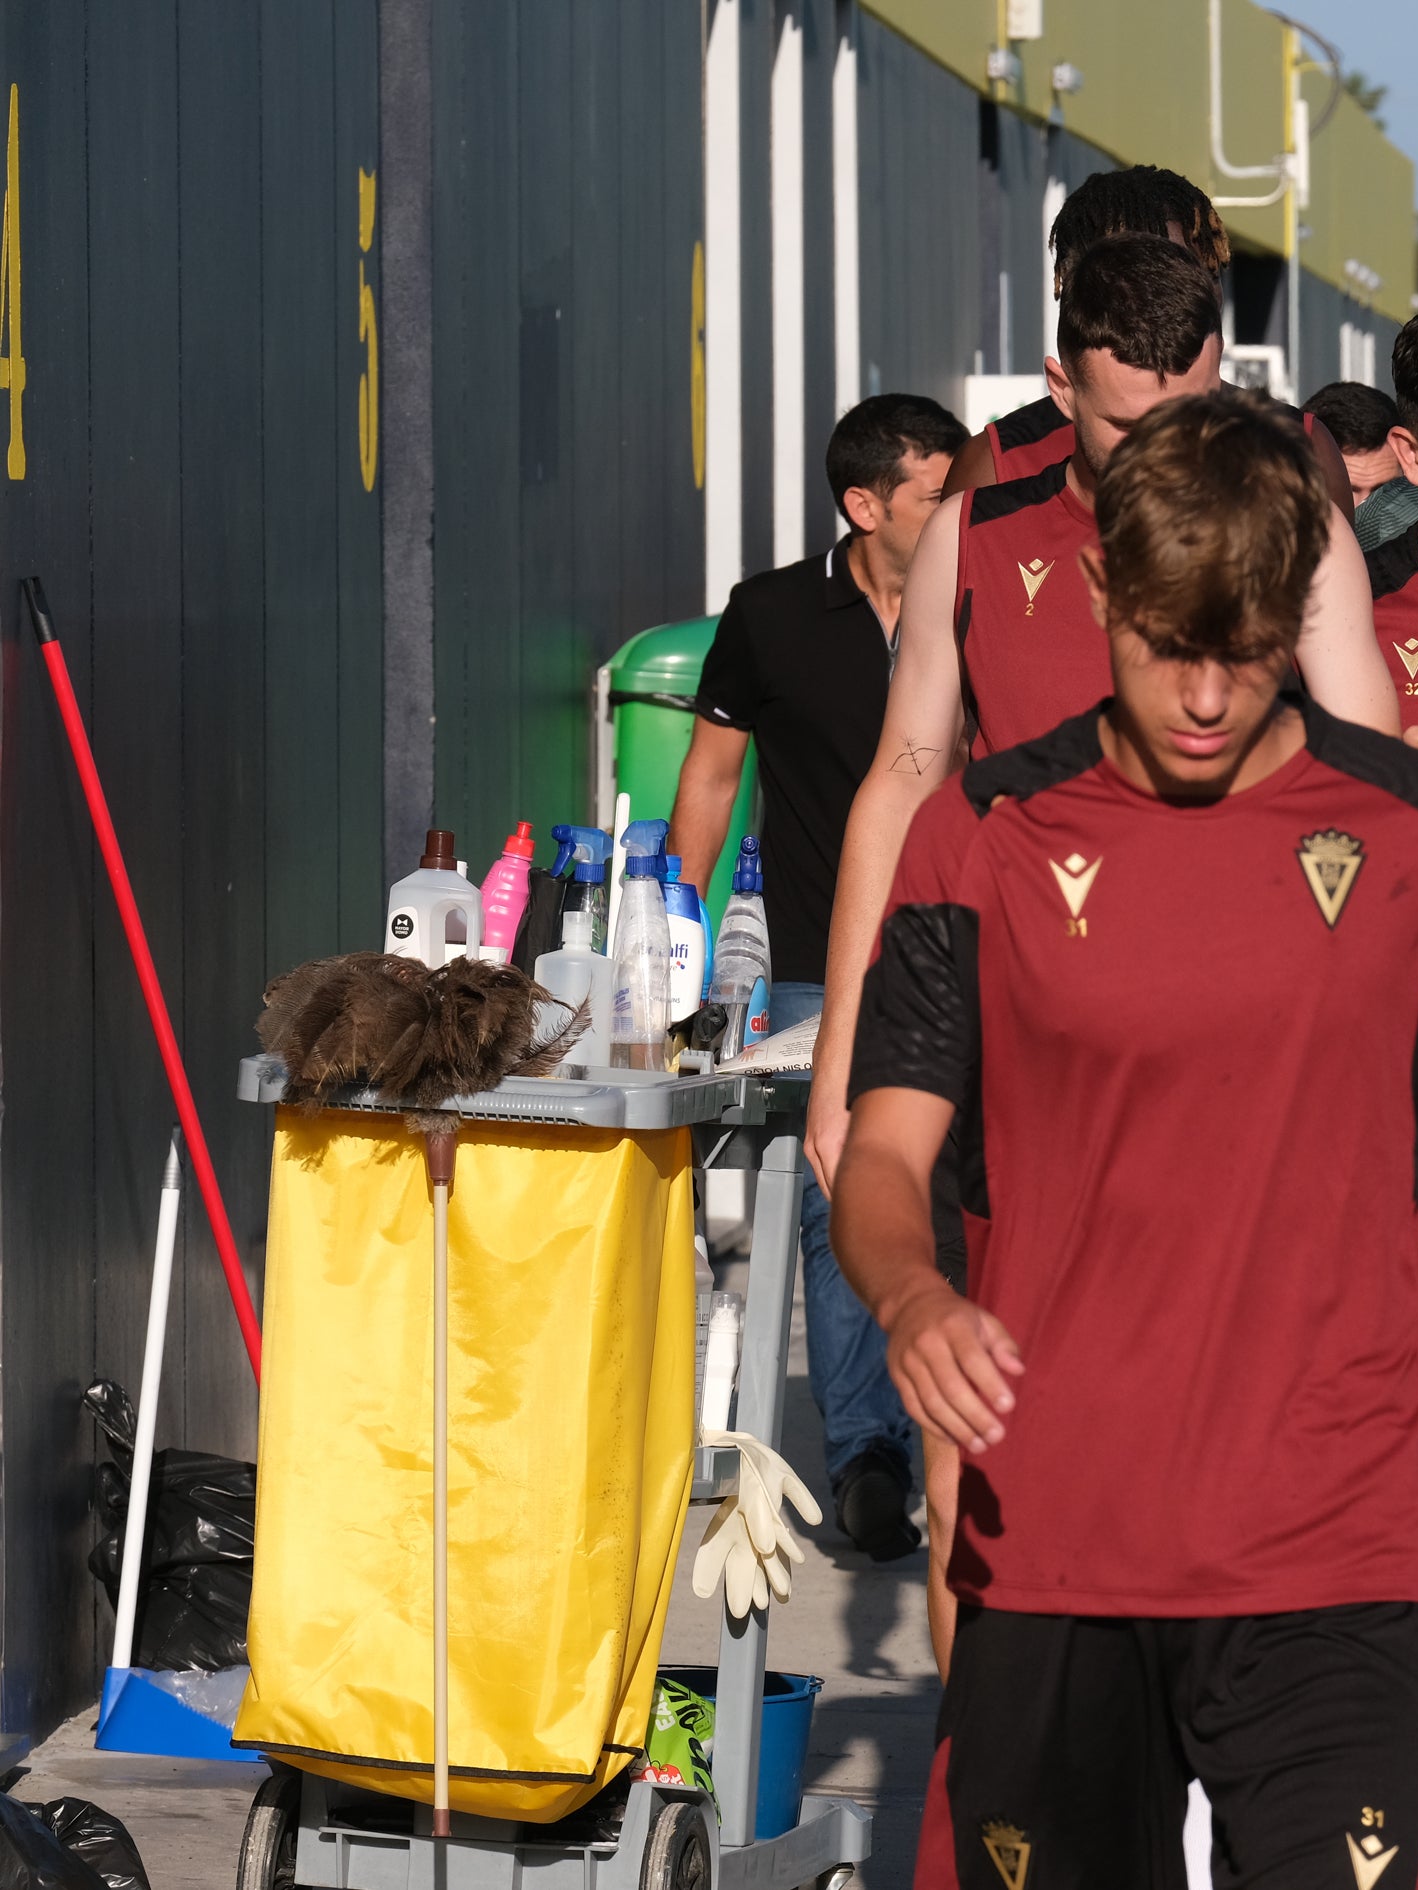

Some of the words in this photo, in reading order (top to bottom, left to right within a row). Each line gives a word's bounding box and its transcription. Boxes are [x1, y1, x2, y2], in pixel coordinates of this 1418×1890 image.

[1025, 602, 1034, 616] 2
[1065, 917, 1088, 938] 31
[1360, 1806, 1384, 1828] 31
